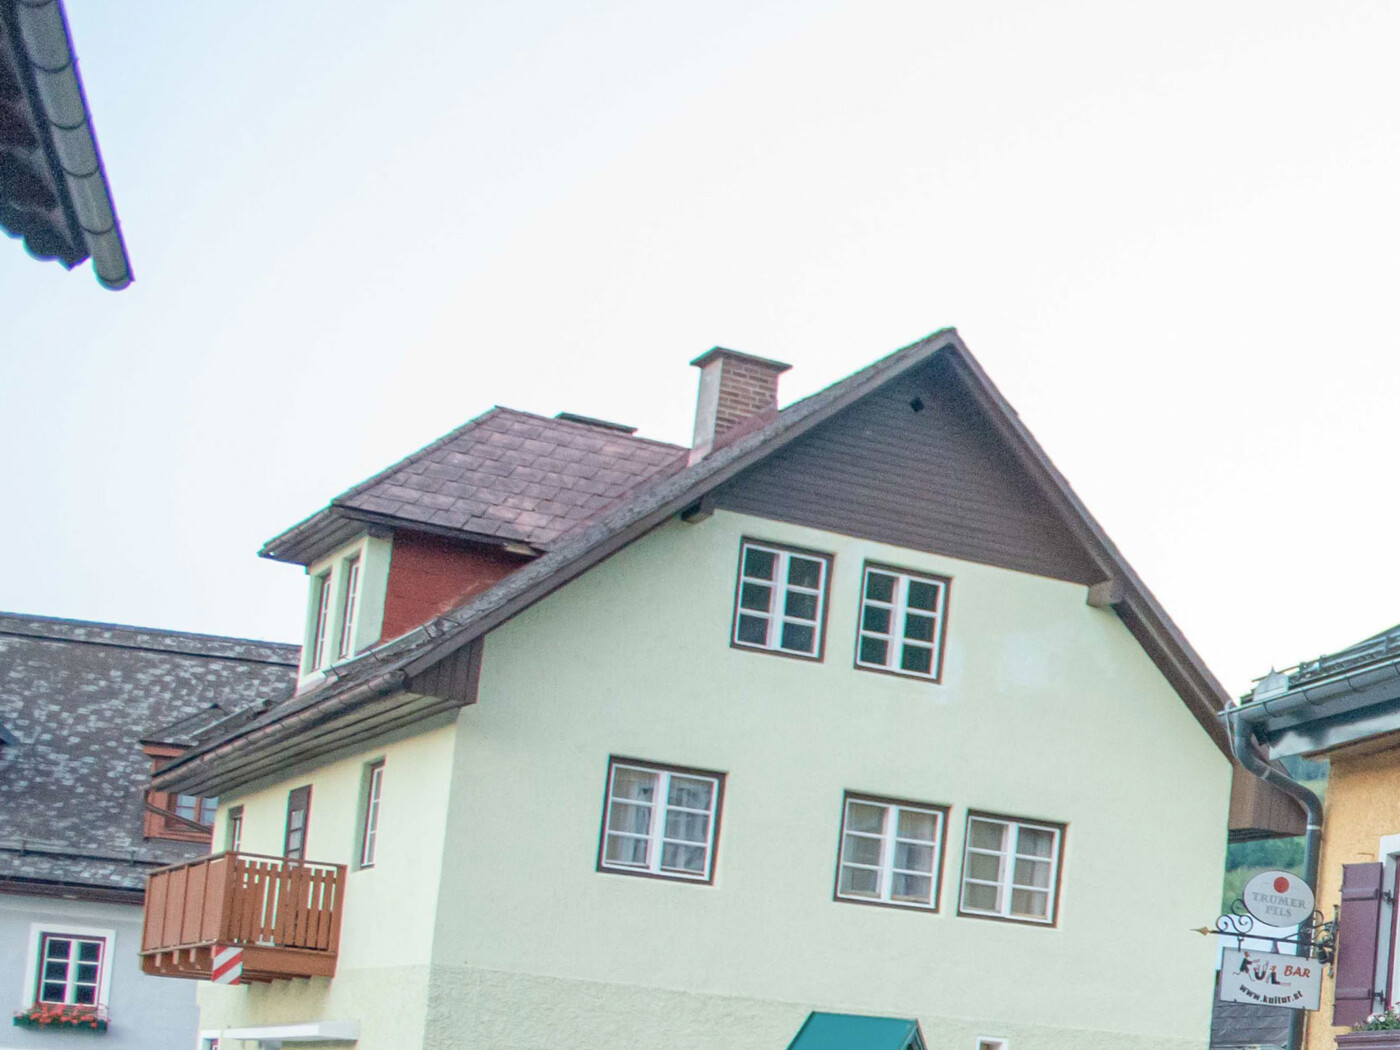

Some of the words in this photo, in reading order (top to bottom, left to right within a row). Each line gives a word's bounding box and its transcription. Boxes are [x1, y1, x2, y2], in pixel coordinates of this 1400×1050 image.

[1252, 891, 1307, 909] TRUMER
[1265, 904, 1292, 918] PILS
[1284, 964, 1311, 979] BAR
